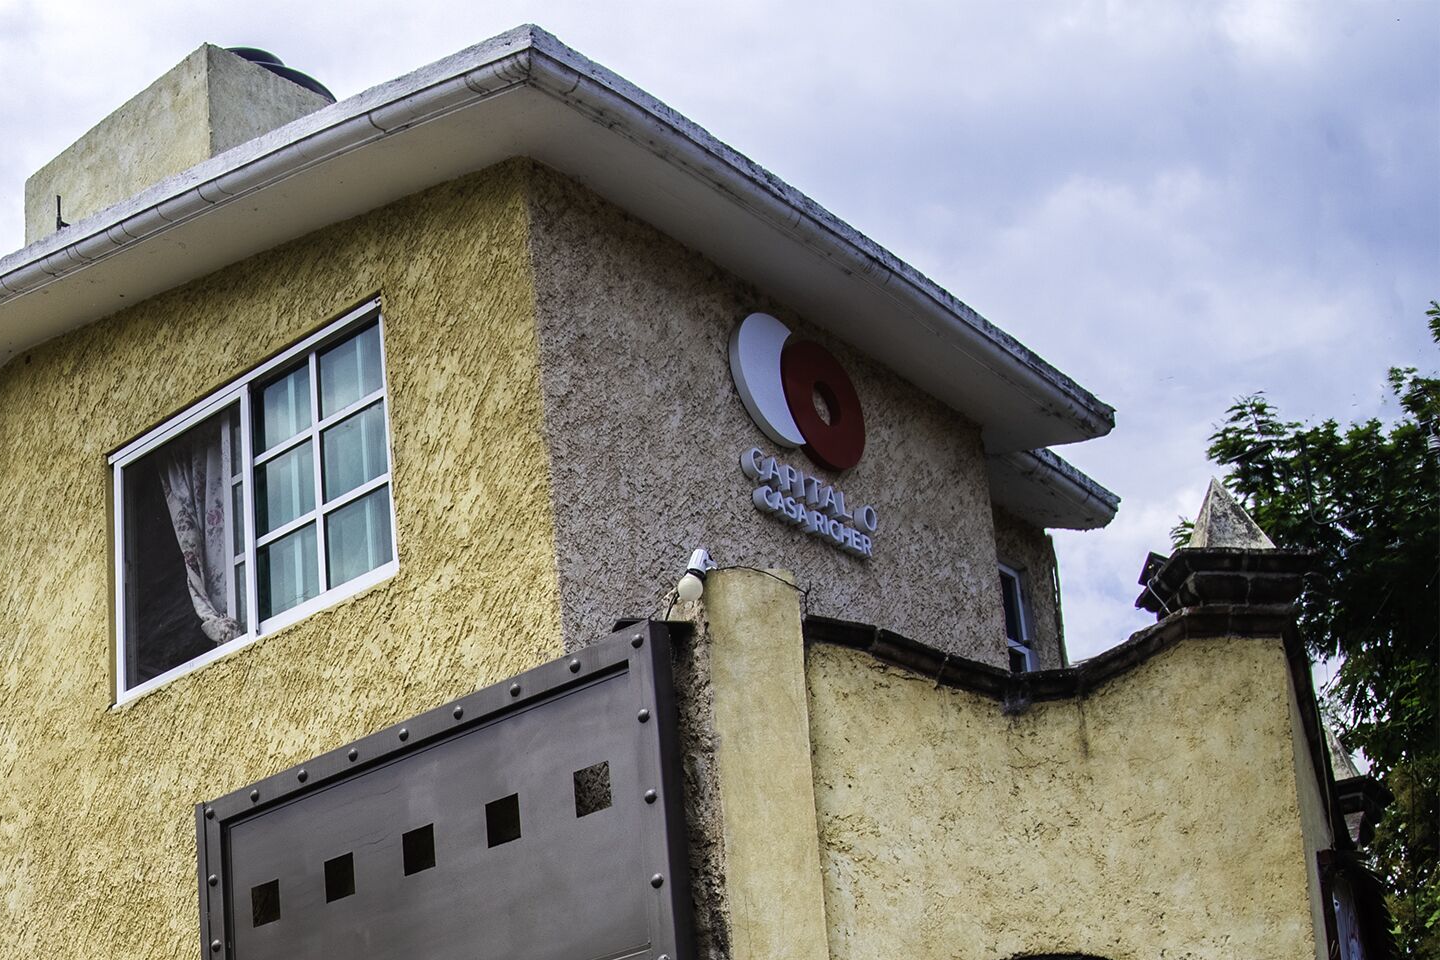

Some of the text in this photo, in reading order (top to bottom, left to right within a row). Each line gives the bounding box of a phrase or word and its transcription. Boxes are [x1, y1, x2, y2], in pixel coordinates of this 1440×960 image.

[742, 448, 852, 520] CAPITAL
[754, 487, 872, 558] CASA RICHER
